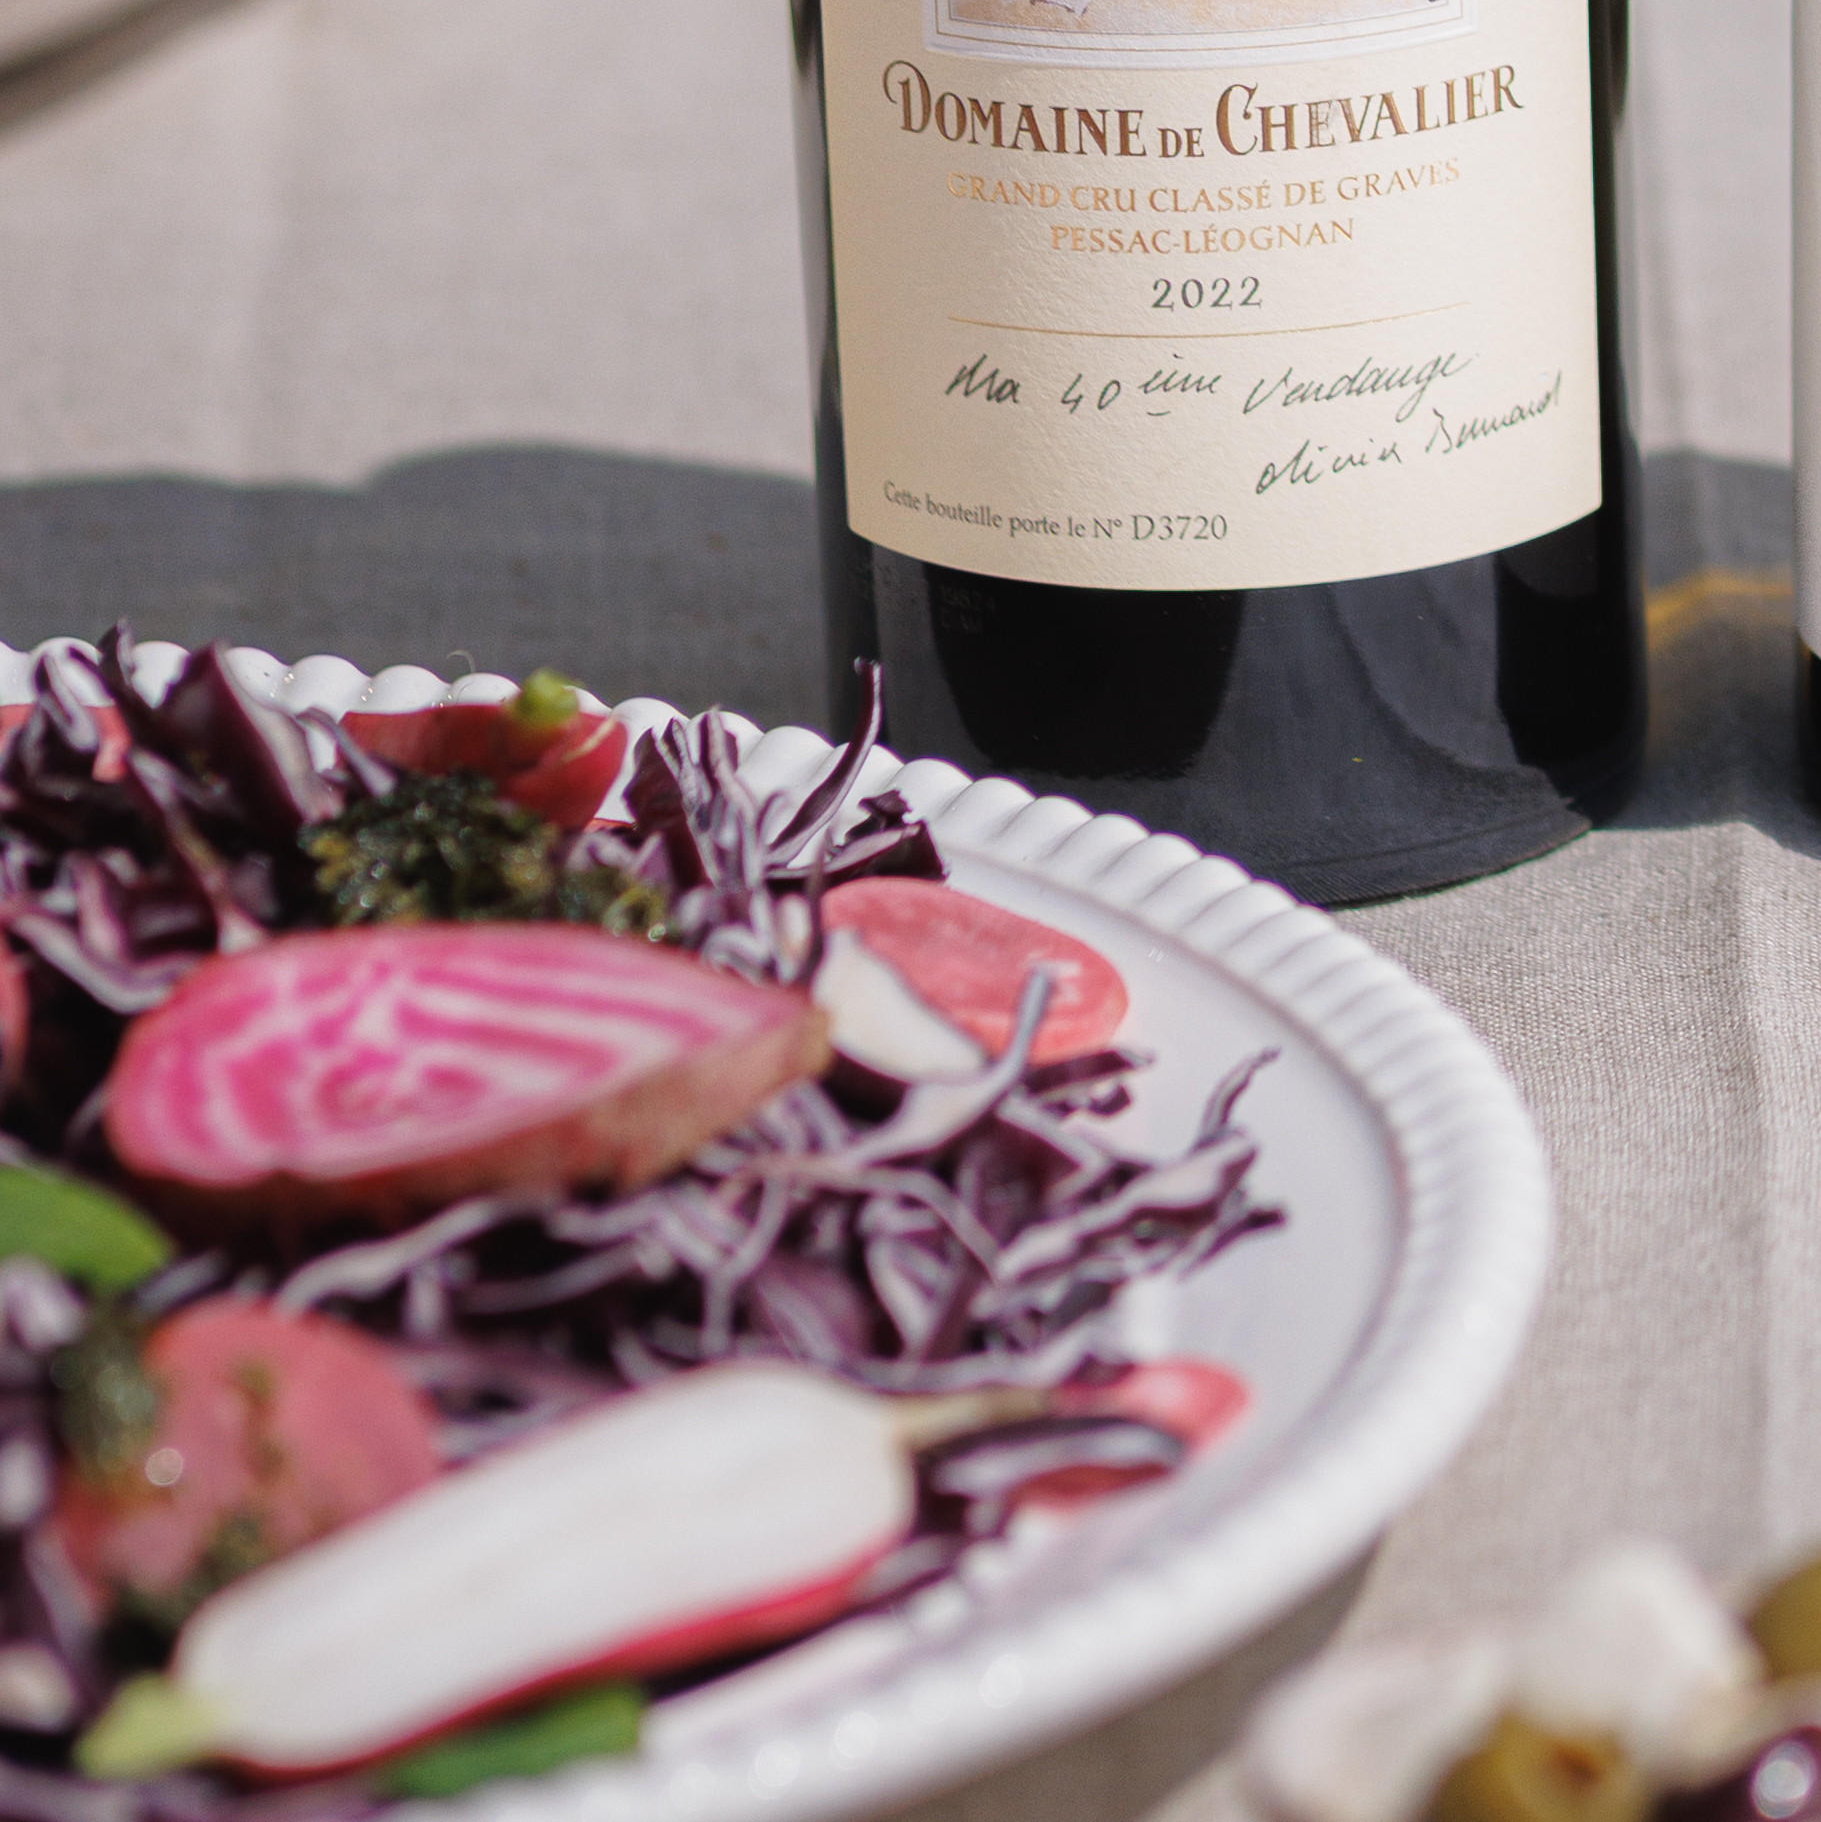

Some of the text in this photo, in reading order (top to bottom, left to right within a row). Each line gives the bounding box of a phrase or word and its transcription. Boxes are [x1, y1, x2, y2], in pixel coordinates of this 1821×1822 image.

[882, 58, 1525, 159] DOMAINE DE CHEVALIER
[945, 156, 1462, 215] GRAND CRU CLASSÉ DE GRAVES
[1048, 216, 1357, 256] PESSAC-LÉOGNAN
[1150, 276, 1264, 311] 2022
[883, 479, 923, 512] Cette
[924, 492, 1003, 530] bouteille
[1008, 515, 1061, 539] porte
[1067, 515, 1087, 539] le
[1130, 513, 1229, 542] D3720
